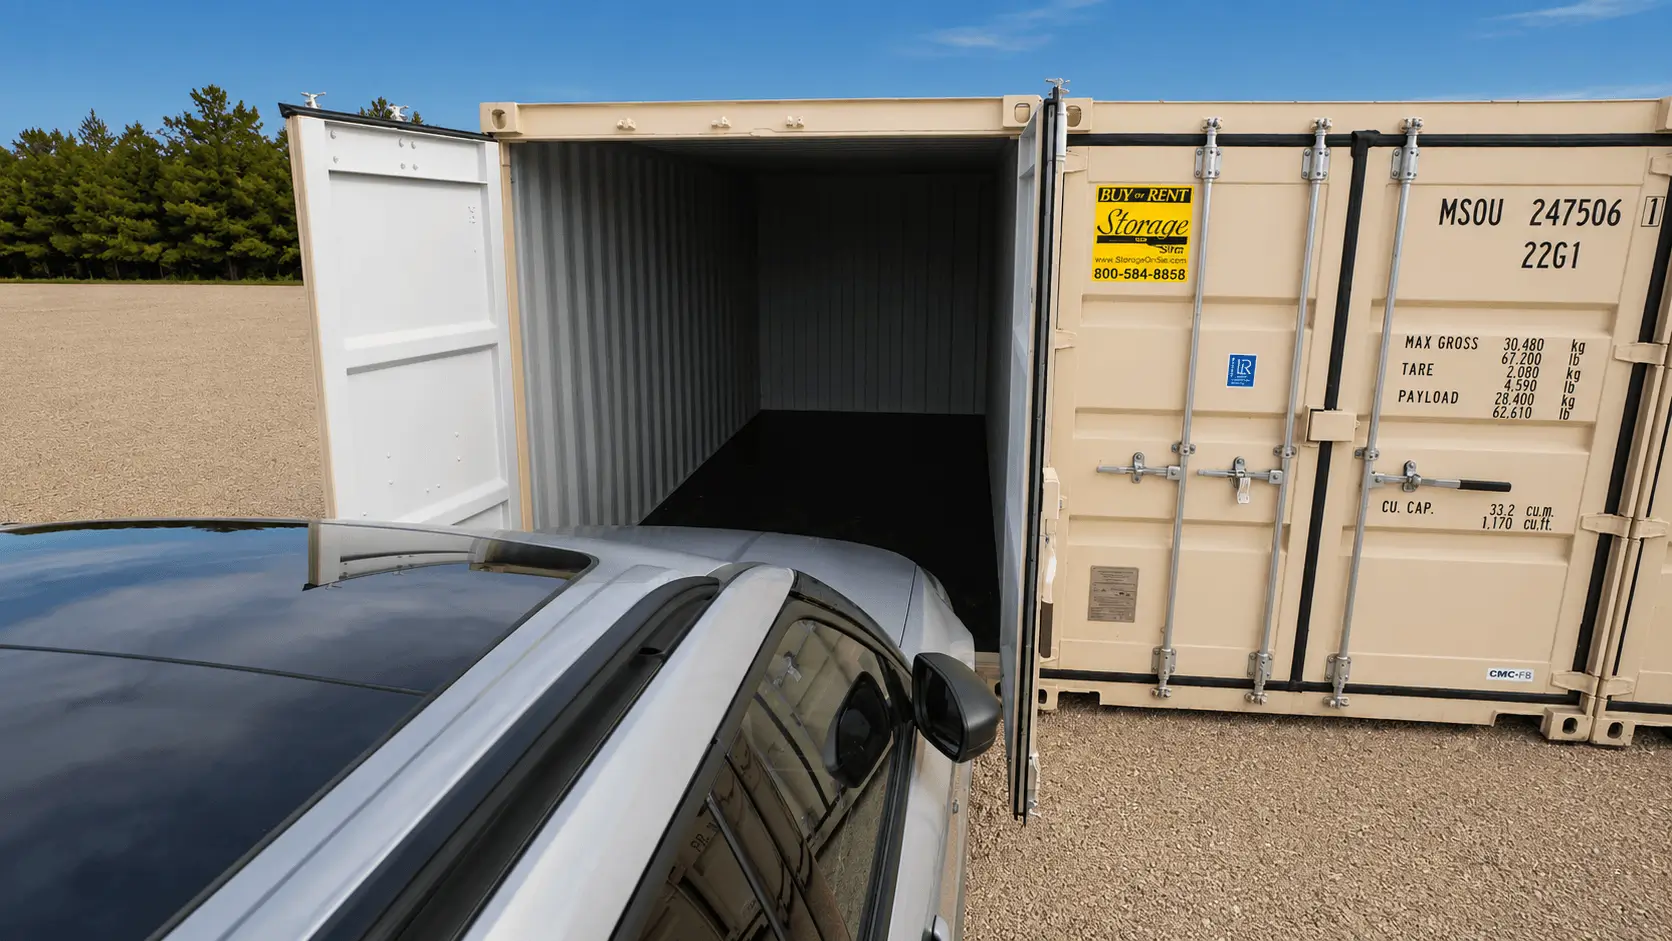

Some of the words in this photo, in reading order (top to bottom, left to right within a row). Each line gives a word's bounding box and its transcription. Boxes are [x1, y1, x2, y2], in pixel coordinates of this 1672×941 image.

[1100, 188, 1134, 202] BUY
[1147, 188, 1189, 202] RENT
[1438, 198, 1504, 226] MSOU
[1529, 198, 1623, 226] 247506
[1647, 197, 1659, 225] 1
[1097, 208, 1189, 240] Storage
[1521, 241, 1581, 269] 22G1
[1094, 268, 1186, 280] 800-584-8858
[1404, 335, 1432, 350] MAX
[1438, 336, 1479, 350] GROSS
[1503, 337, 1545, 351] 30.480
[1571, 338, 1586, 355] kg
[1501, 352, 1542, 366] 67.200
[1568, 354, 1580, 367] lb
[1402, 362, 1435, 376] TARE
[1506, 365, 1540, 379] 2.080
[1565, 367, 1581, 383] kg
[1503, 379, 1537, 393] 4.590
[1563, 380, 1575, 394] lb
[1397, 389, 1459, 404] PAYLOAD
[1494, 392, 1535, 406] 28.400
[1560, 394, 1576, 410] kg
[1558, 408, 1570, 421] lb
[1381, 501, 1400, 513] CU.
[1407, 501, 1434, 515] CAP.
[1489, 503, 1516, 517] 33.2
[1526, 505, 1555, 518] cu.m.
